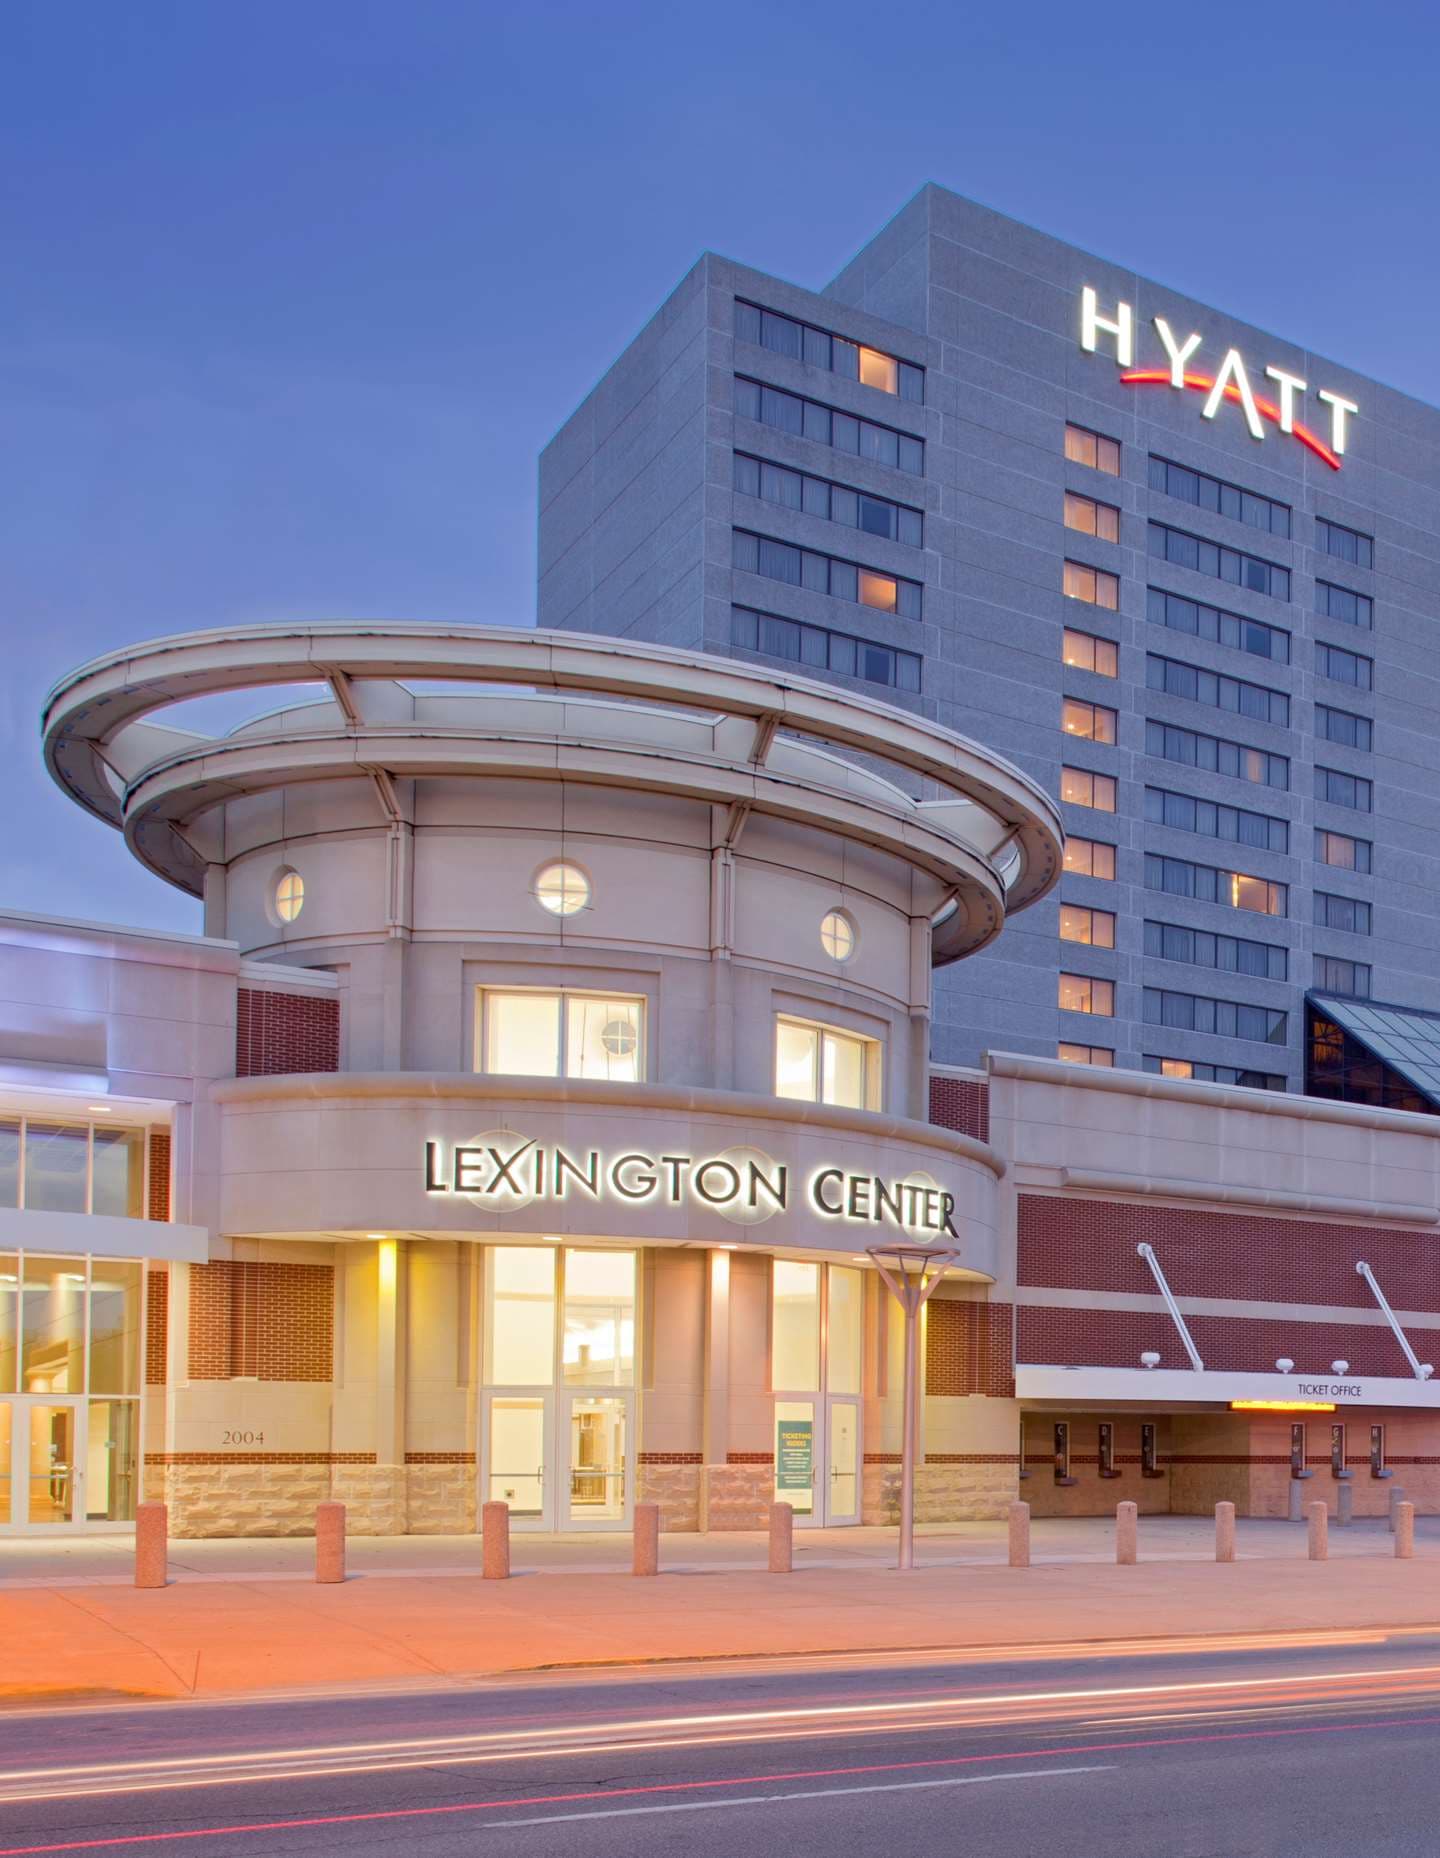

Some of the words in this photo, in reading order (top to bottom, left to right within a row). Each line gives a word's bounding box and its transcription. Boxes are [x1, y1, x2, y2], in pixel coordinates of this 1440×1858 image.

[1081, 286, 1358, 455] HYATT
[425, 1138, 788, 1210] LEXINGTON
[812, 1168, 960, 1239] CENTER
[1298, 1384, 1328, 1396] TICKET
[1330, 1384, 1362, 1397] OFFICE
[222, 1430, 264, 1445] 2004
